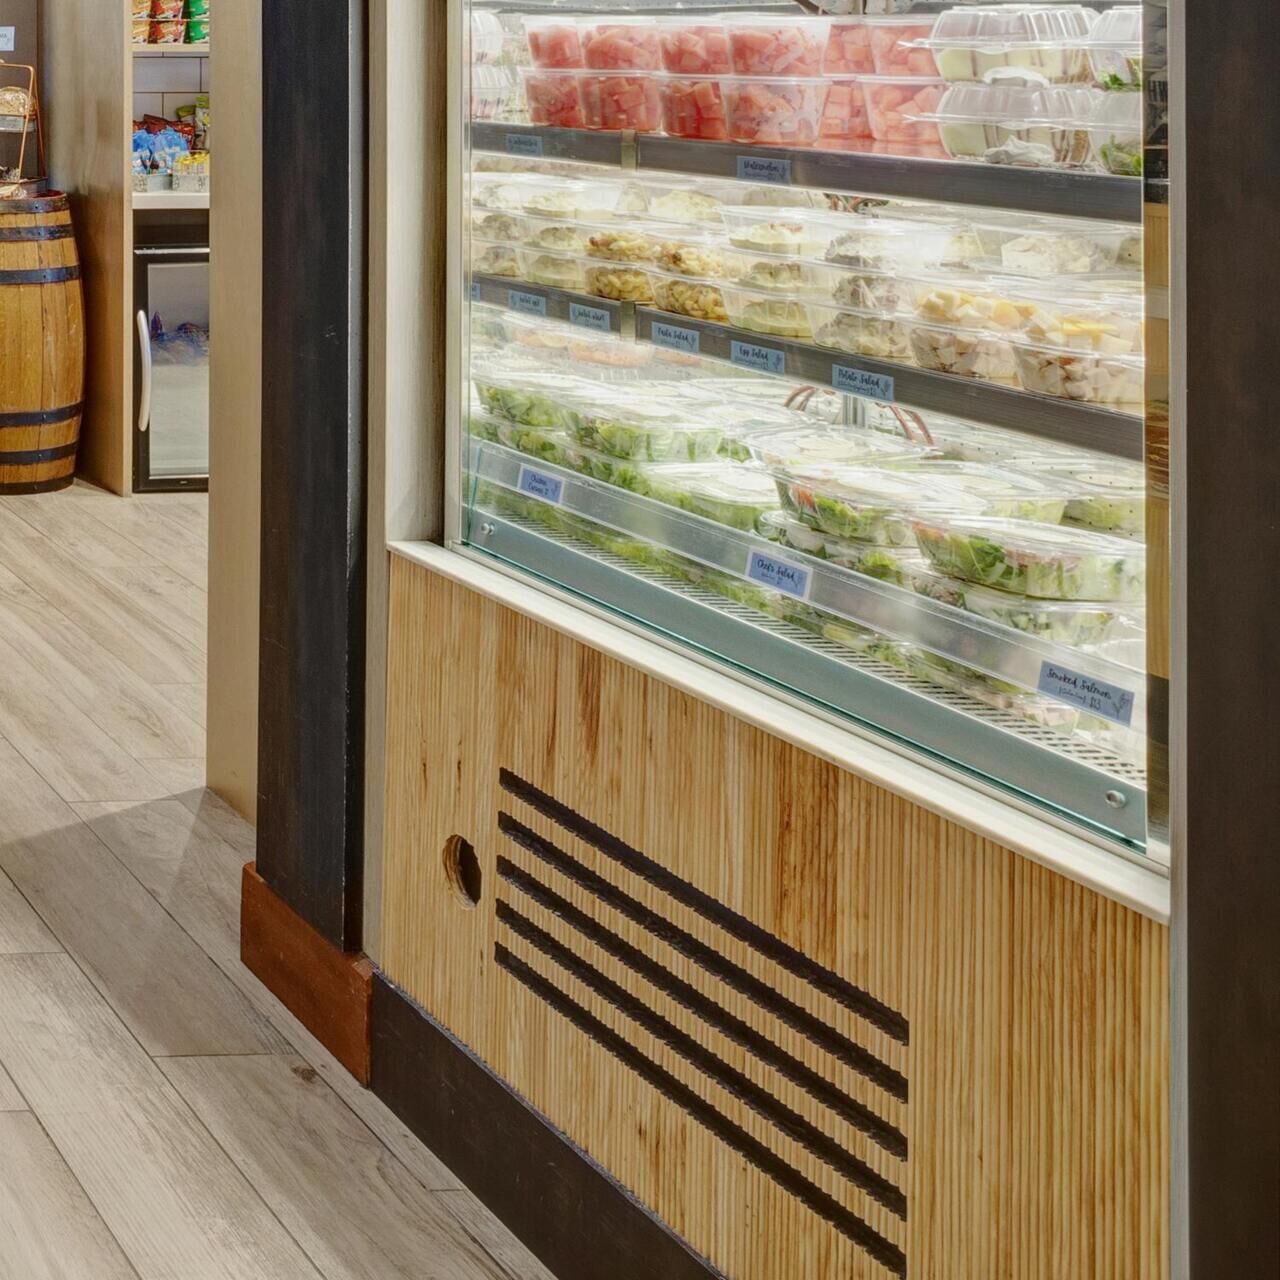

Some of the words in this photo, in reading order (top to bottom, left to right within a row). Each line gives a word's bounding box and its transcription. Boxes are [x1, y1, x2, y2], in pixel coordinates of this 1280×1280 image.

[673, 329, 689, 342] Salad
[751, 348, 768, 361] Salad
[860, 373, 880, 389] Salad
[1046, 668, 1078, 688] Smoked
[1079, 679, 1112, 700] Salmon
